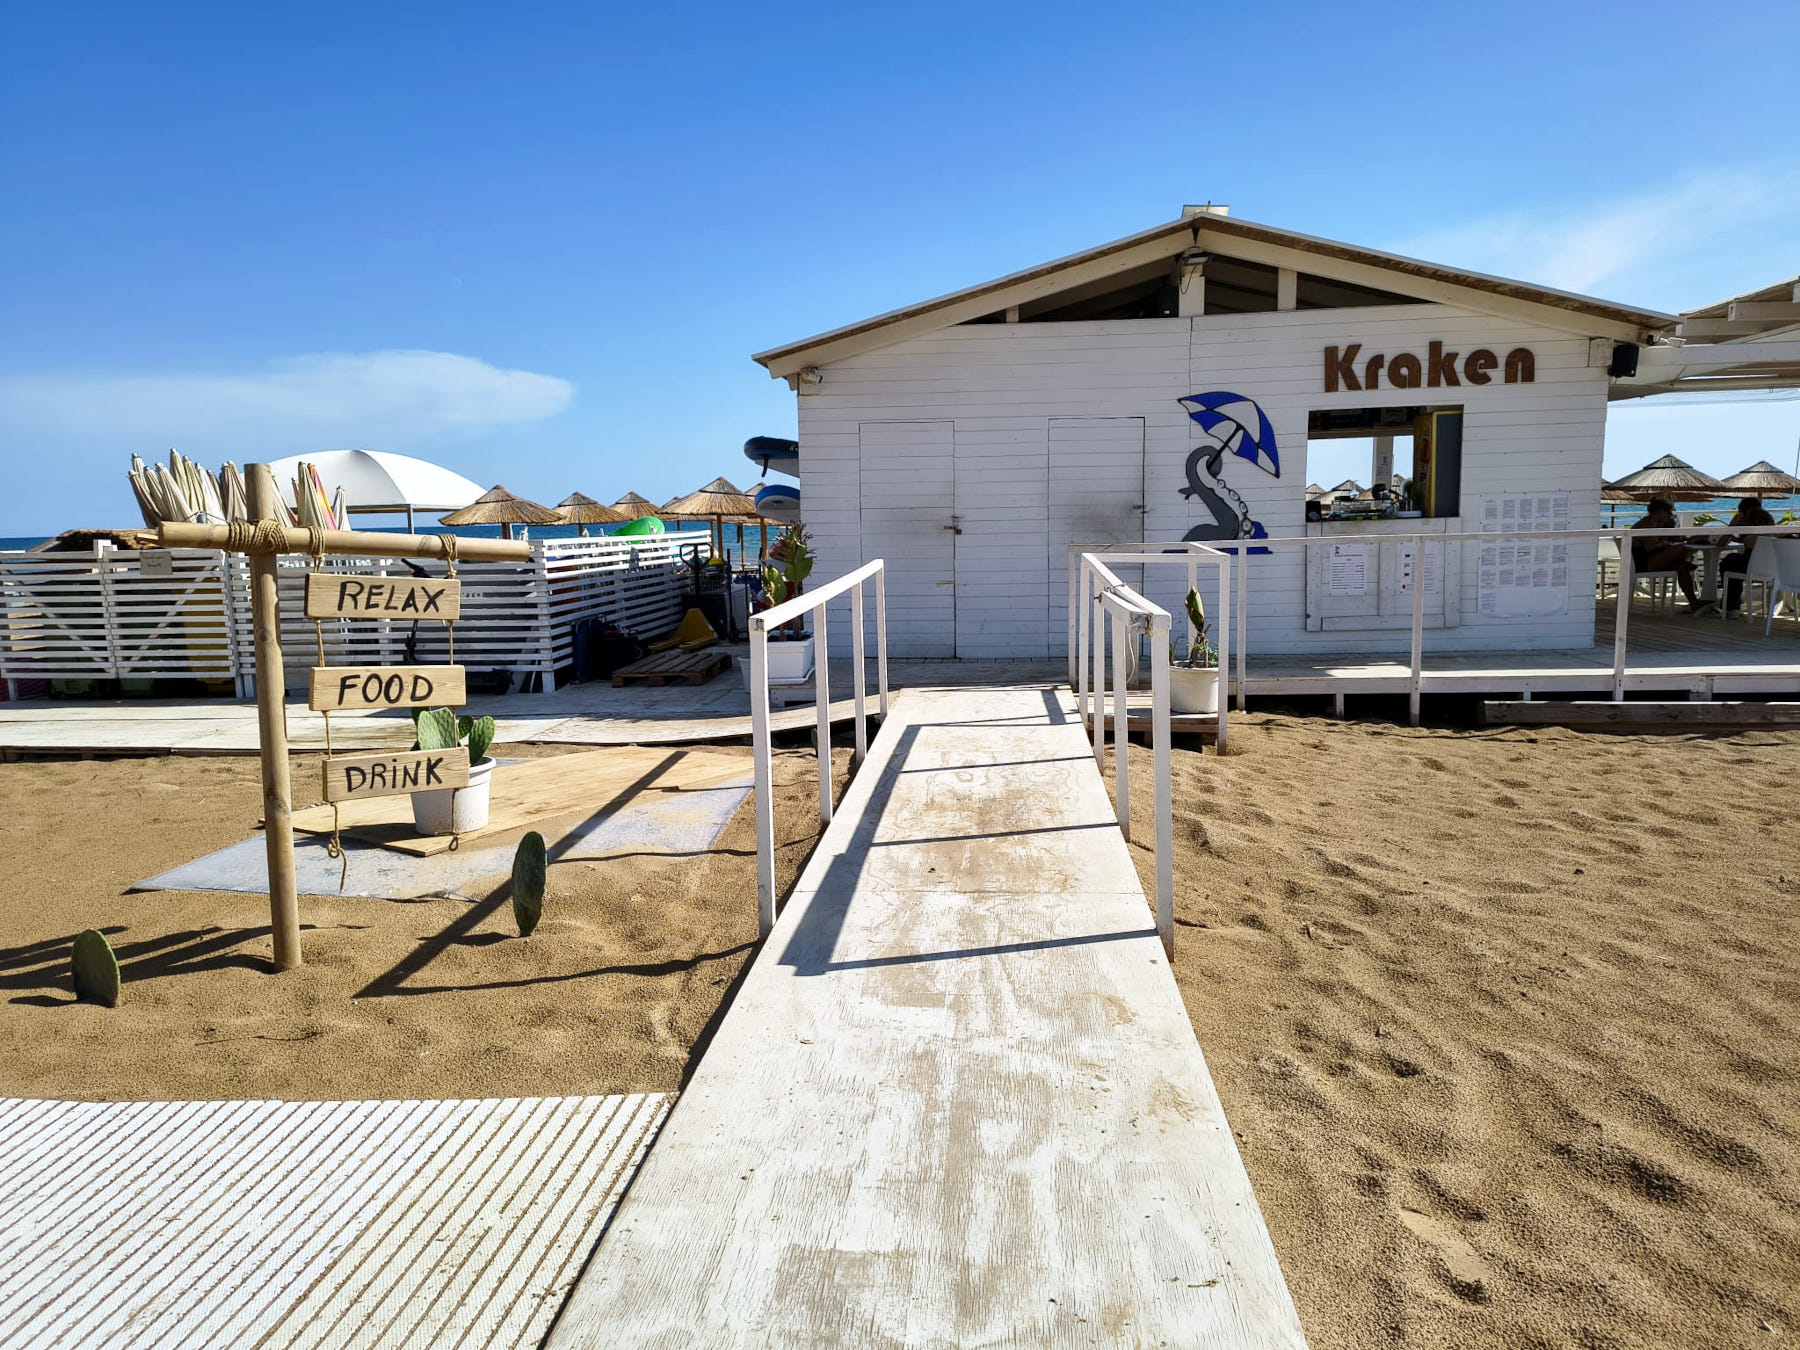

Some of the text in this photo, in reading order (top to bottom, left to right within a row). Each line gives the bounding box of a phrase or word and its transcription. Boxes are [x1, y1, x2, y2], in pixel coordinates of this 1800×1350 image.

[1323, 341, 1535, 393] Kraken
[337, 580, 446, 614] RELAX
[337, 673, 433, 705] FOOD
